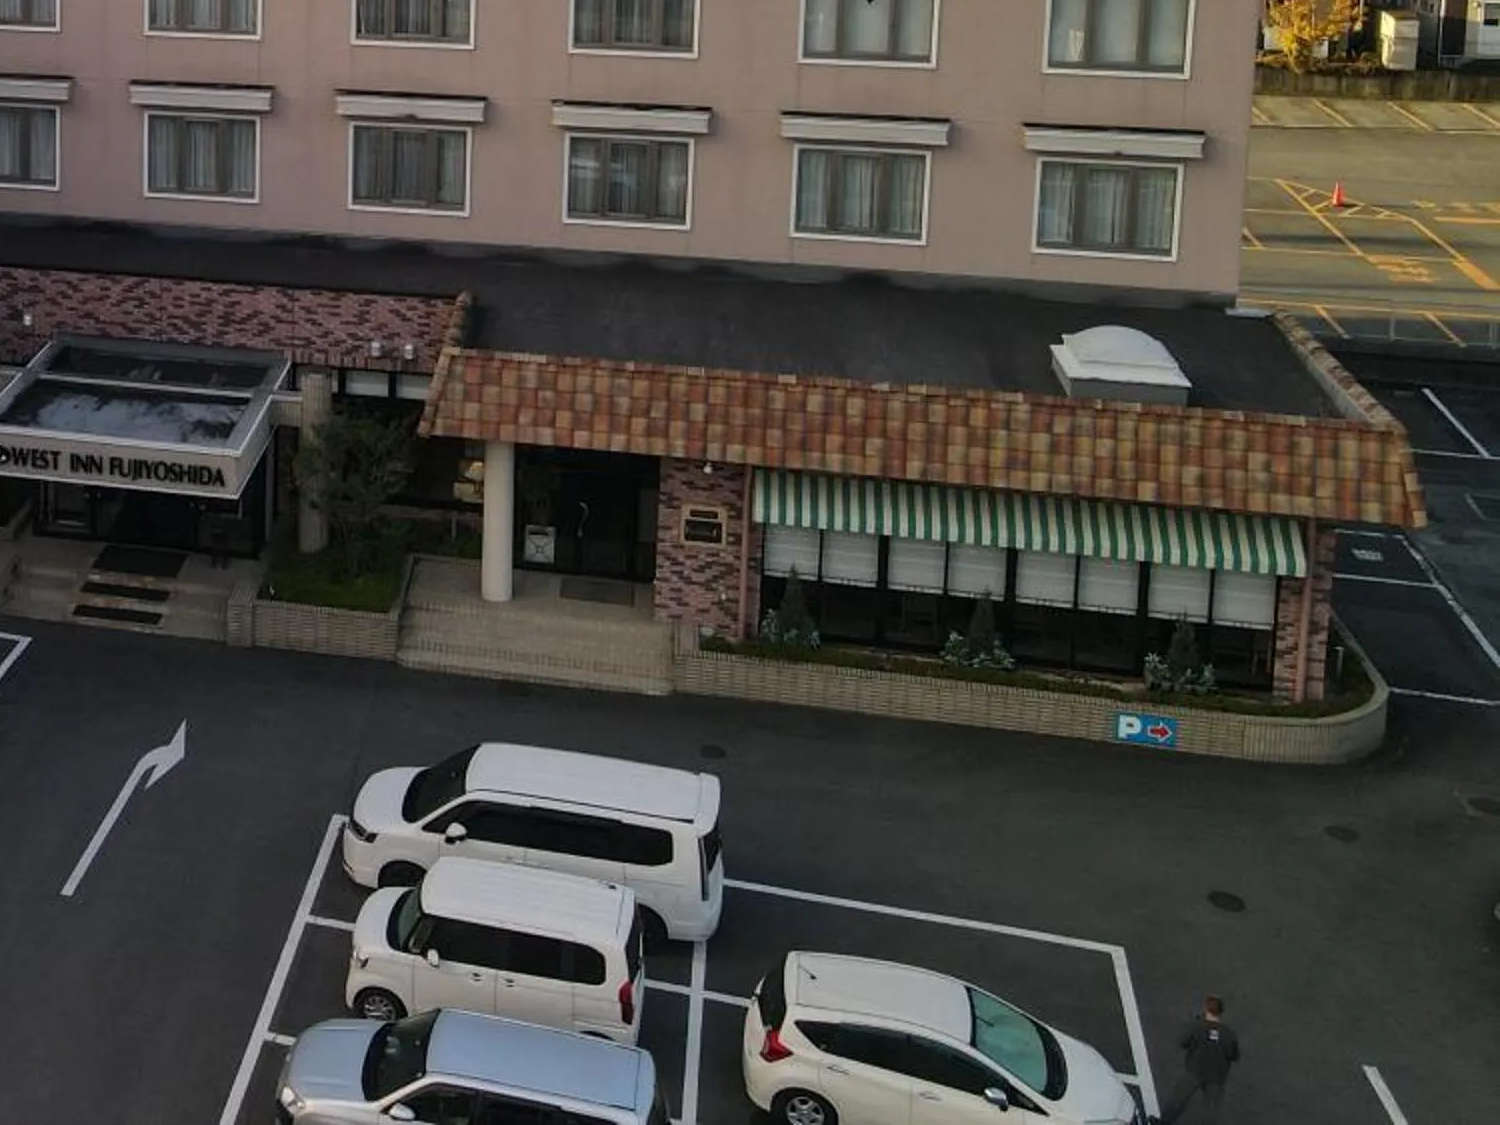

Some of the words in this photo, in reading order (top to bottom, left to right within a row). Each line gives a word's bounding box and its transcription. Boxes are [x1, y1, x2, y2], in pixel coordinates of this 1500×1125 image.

[11, 446, 61, 471] WEST
[69, 453, 103, 474] INN
[109, 457, 225, 487] FUJIYOSHIDA
[1118, 715, 1142, 739] P
